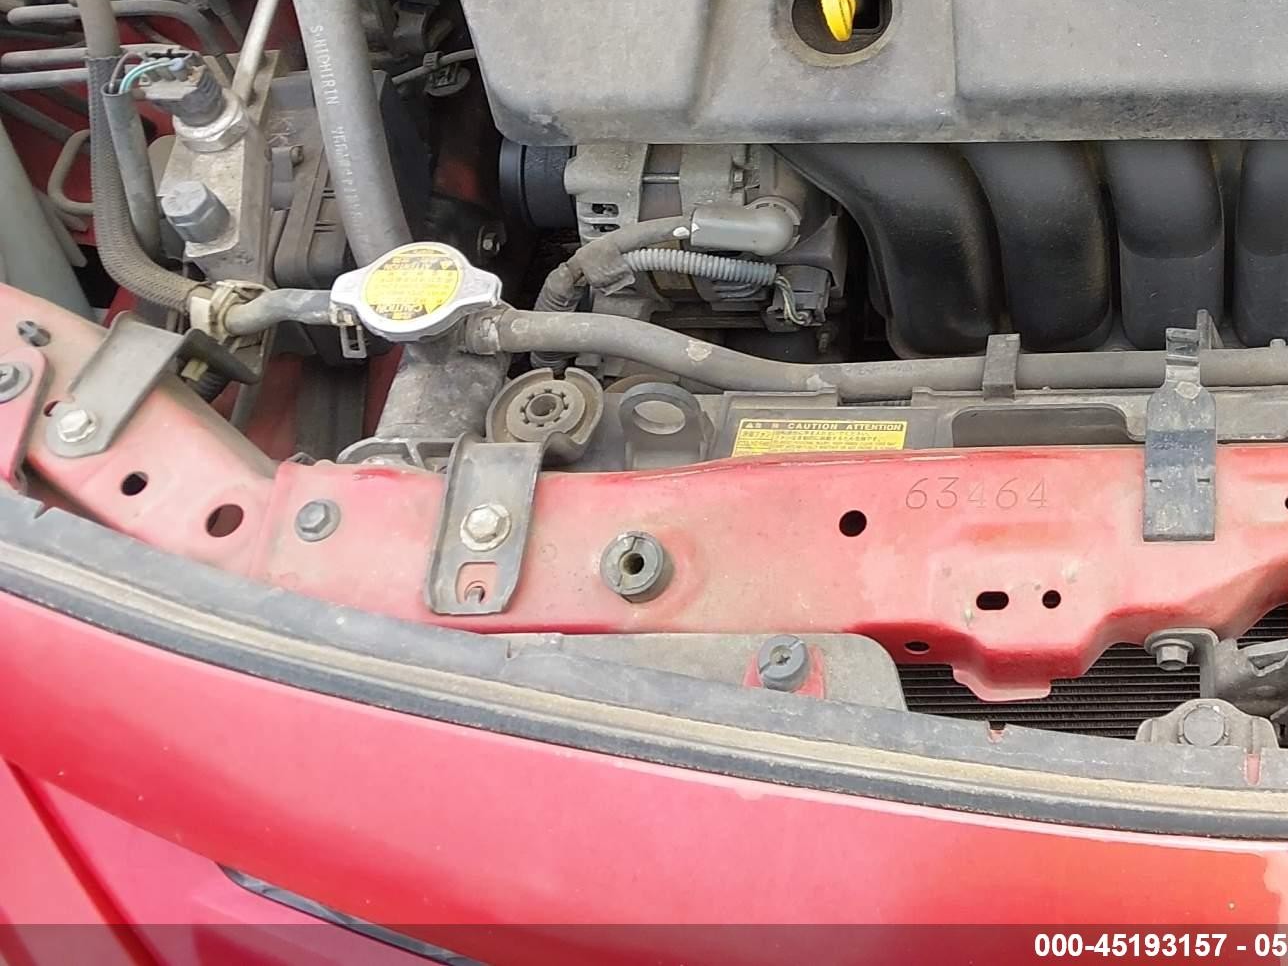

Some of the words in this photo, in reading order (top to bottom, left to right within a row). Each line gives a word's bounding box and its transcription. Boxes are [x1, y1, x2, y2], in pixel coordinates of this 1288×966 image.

[375, 303, 423, 314] CAUTION
[788, 422, 838, 431] CAUTION
[846, 423, 902, 432] ATTENTION
[905, 476, 1048, 510] 63464
